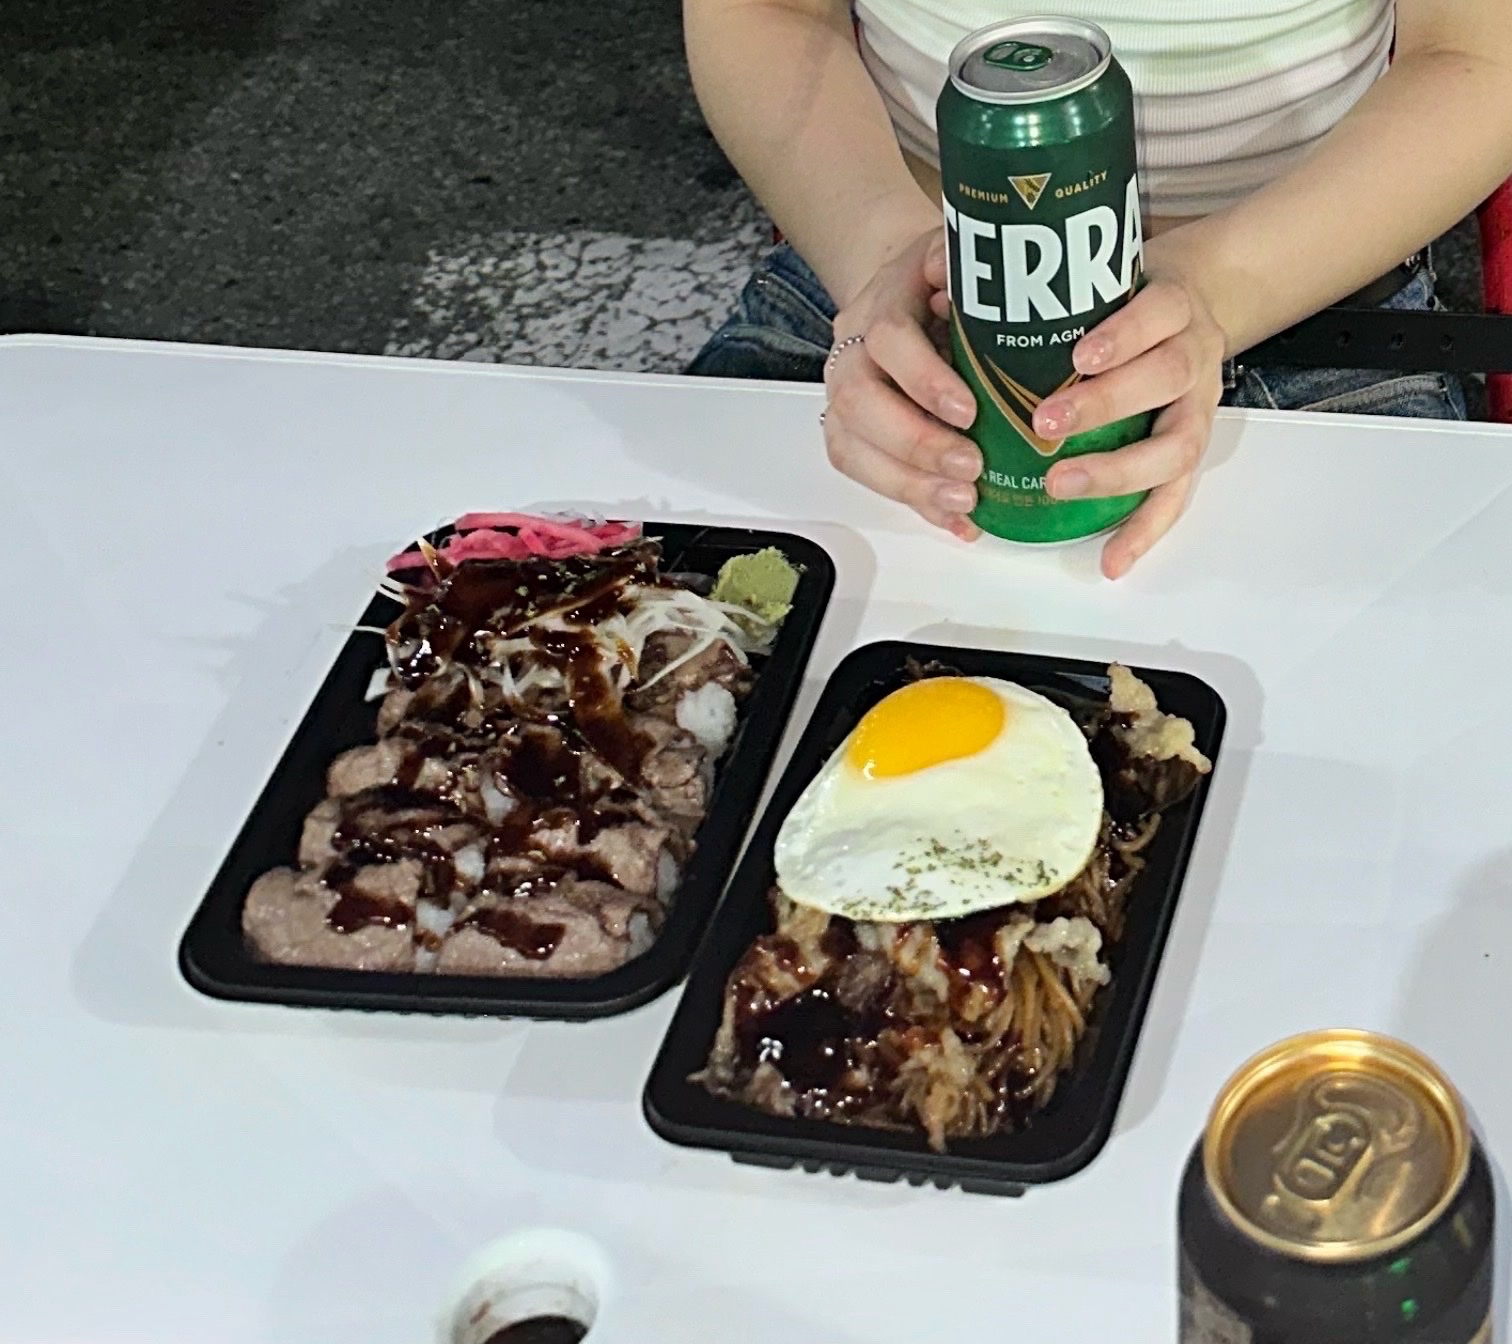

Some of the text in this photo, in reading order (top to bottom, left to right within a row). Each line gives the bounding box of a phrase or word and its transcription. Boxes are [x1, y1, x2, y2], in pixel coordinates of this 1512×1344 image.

[958, 169, 1108, 204] PREMIUM QUALITY
[996, 332, 1044, 348] FROM
[988, 469, 1019, 490] REAL
